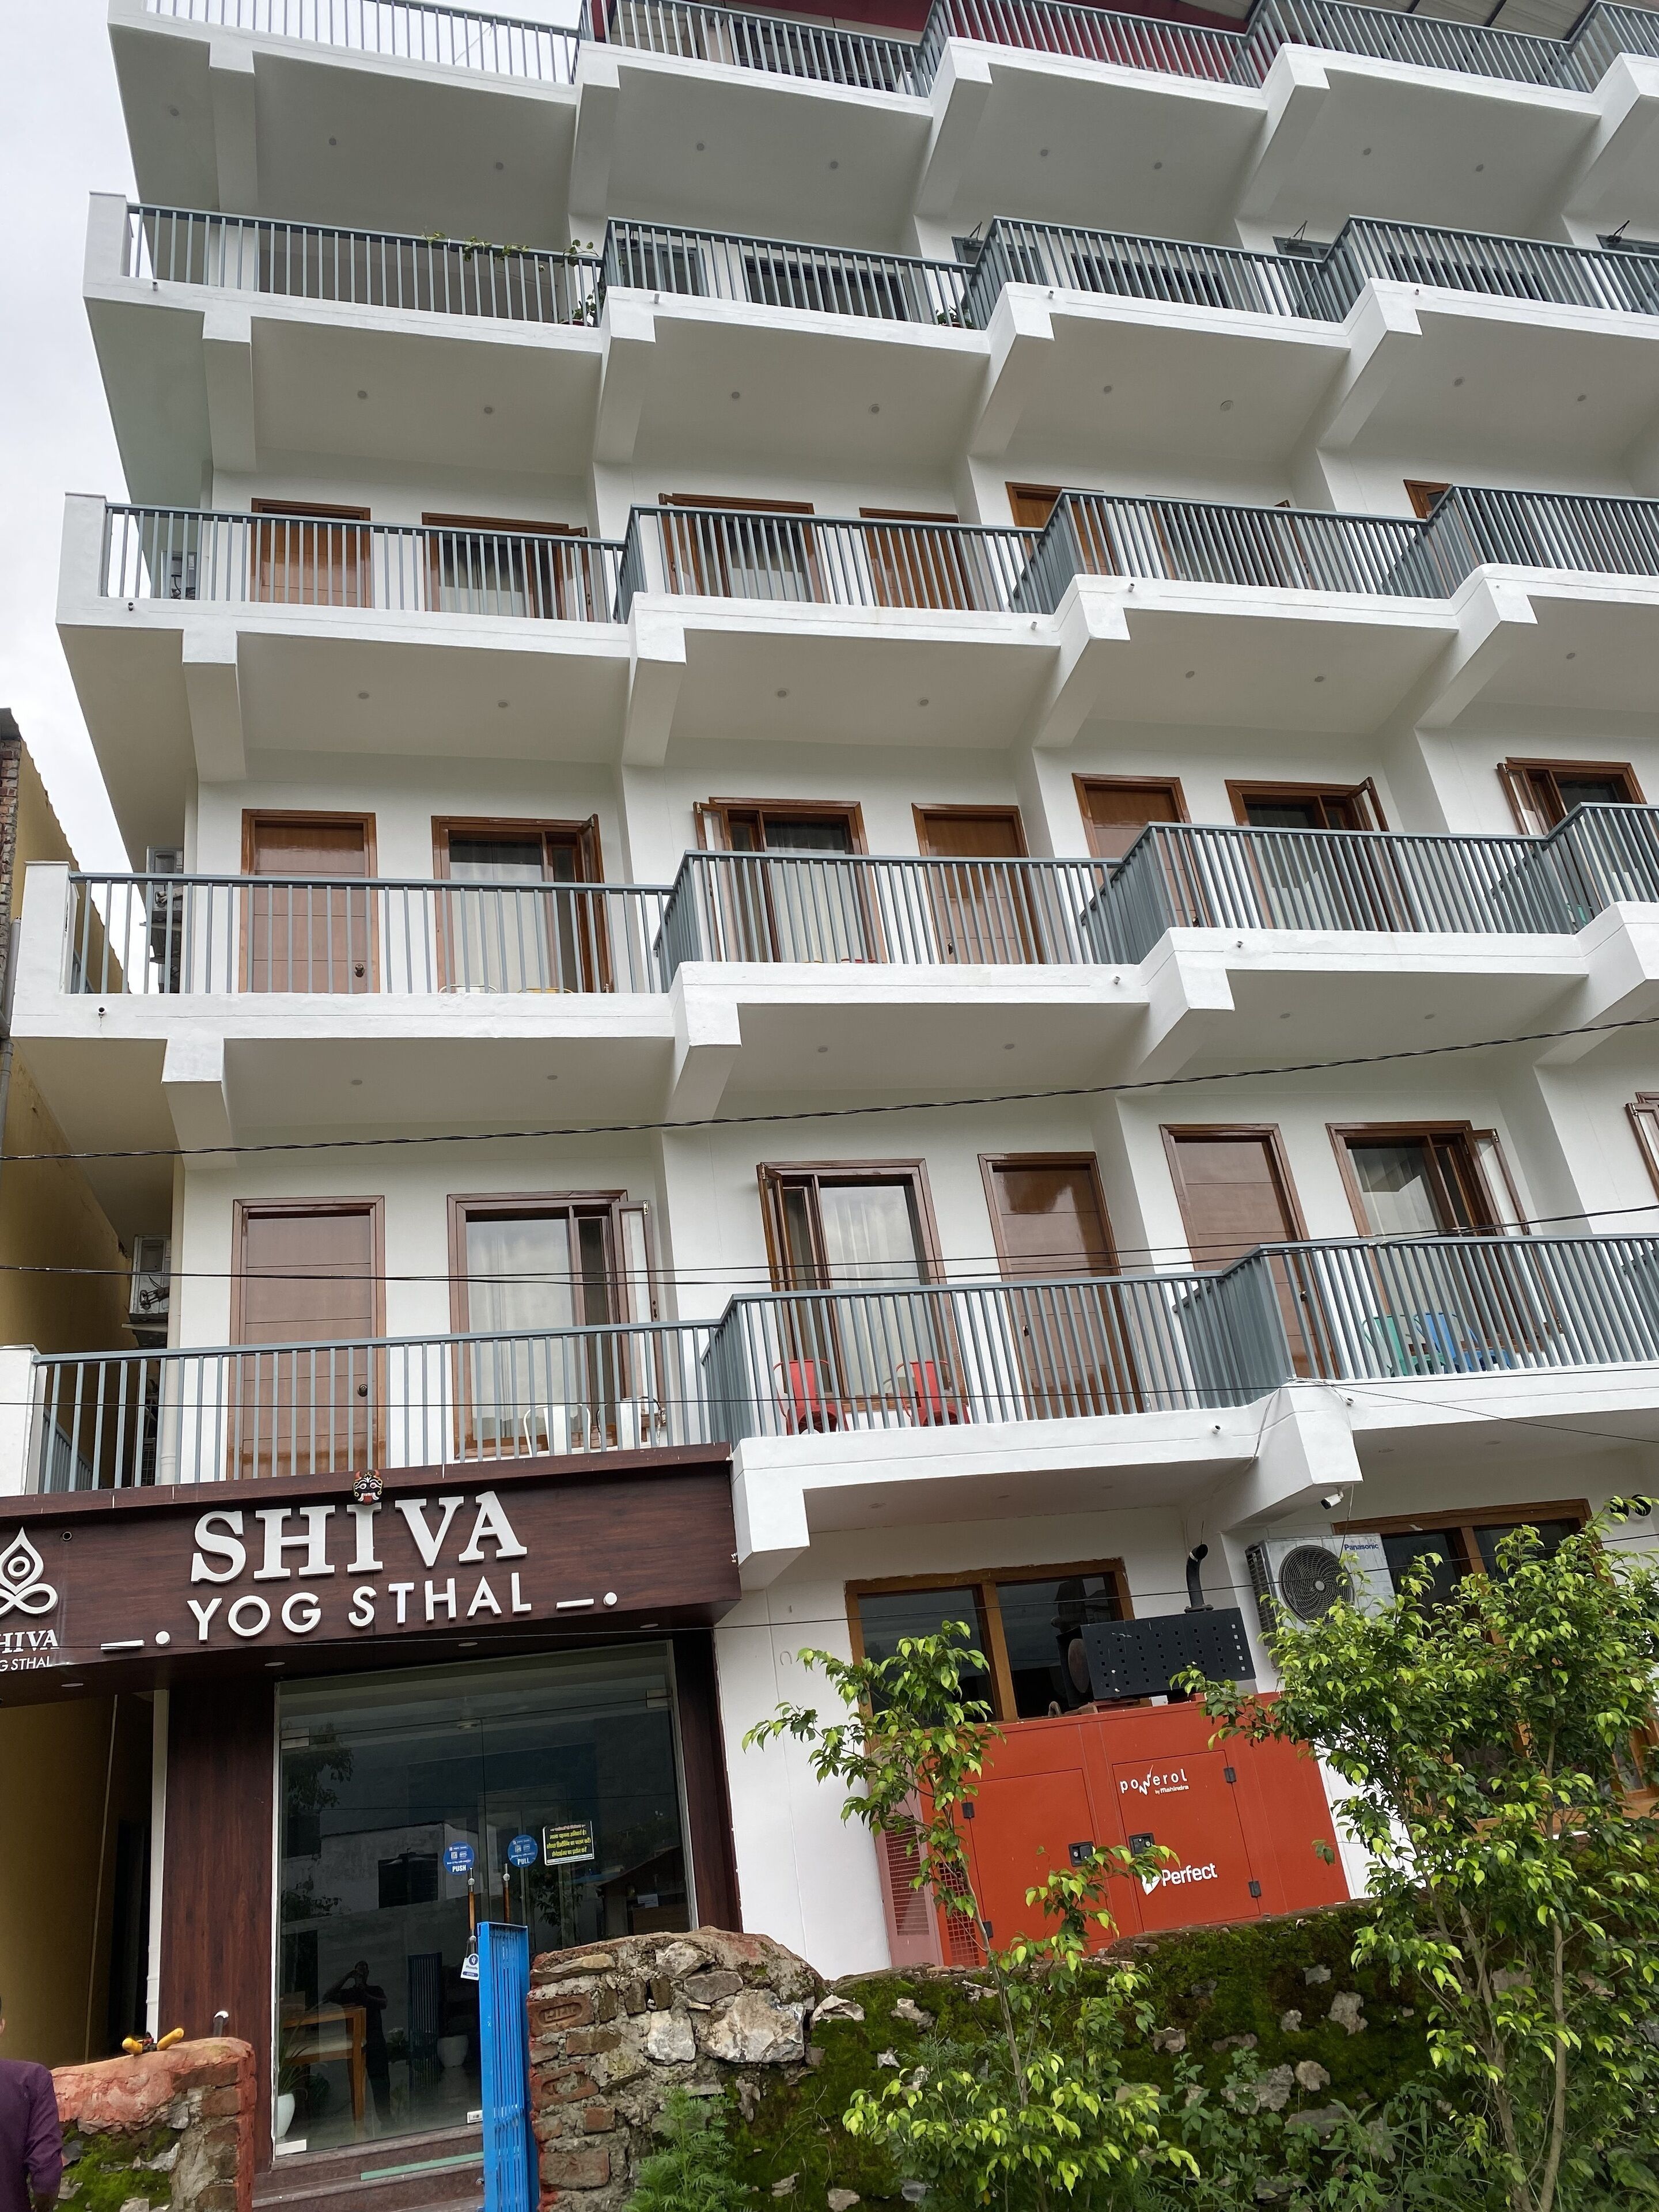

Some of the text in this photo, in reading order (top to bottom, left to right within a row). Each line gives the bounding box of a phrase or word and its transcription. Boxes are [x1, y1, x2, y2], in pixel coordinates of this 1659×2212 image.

[191, 1491, 528, 1584] SHIVA
[187, 1572, 532, 1642] YOG STHAL
[0, 1629, 60, 1654] HIVA
[452, 1864, 467, 1872] PUSH
[517, 1857, 530, 1865] PULL
[1161, 1862, 1218, 1887] Perfect
